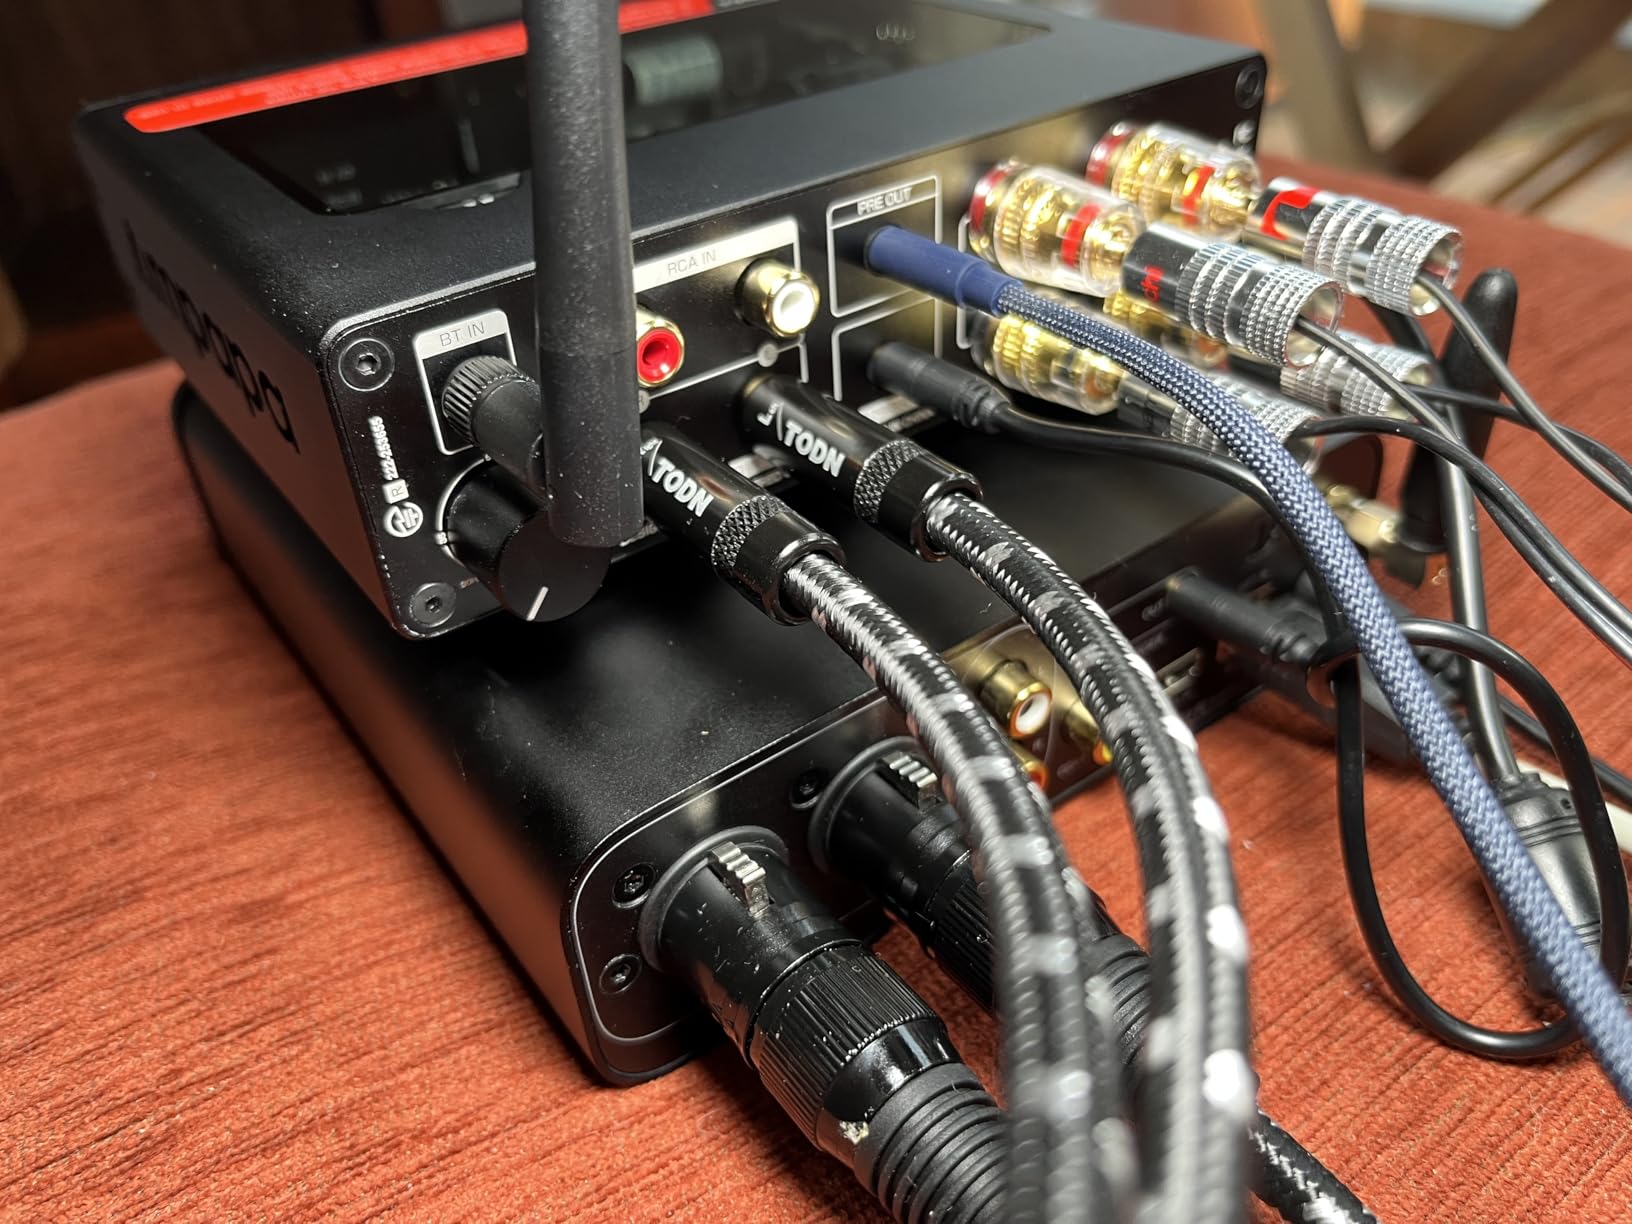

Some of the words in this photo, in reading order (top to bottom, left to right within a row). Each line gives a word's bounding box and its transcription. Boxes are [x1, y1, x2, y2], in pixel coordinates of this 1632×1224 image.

[857, 199, 884, 216] PRE
[885, 187, 912, 207] OUT
[667, 256, 699, 276] RCA
[701, 249, 717, 265] IN
[439, 328, 461, 348] BT
[468, 321, 486, 338] IN
